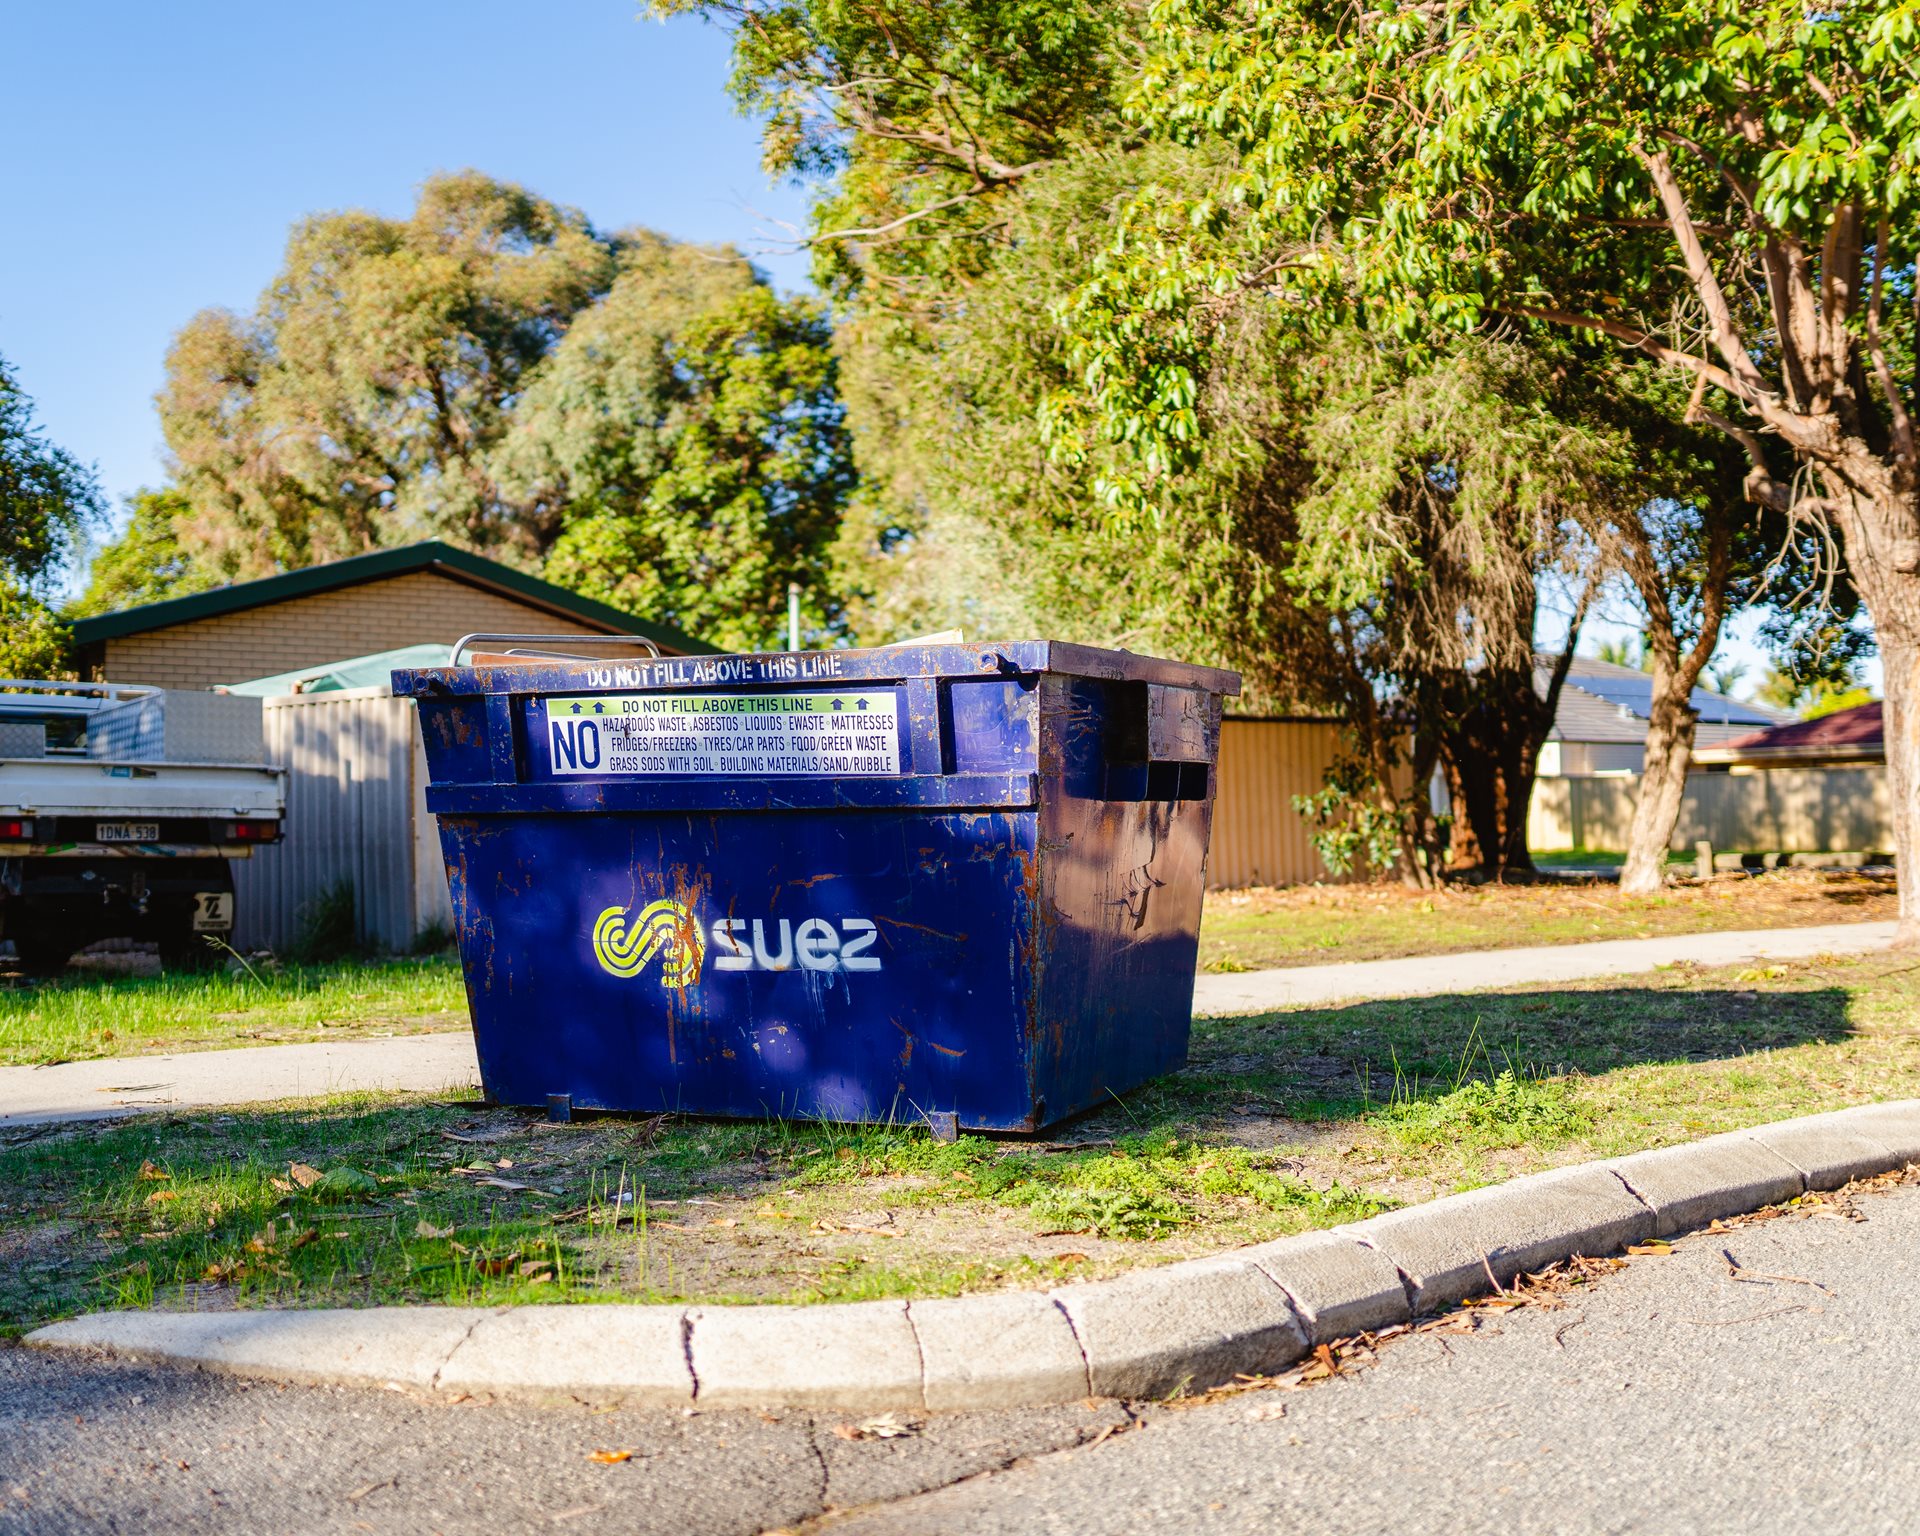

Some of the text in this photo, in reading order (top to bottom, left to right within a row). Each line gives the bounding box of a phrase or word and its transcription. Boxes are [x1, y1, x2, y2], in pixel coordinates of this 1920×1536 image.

[586, 654, 843, 687] DO NOT FILL ABOVE THIS LINE
[623, 698, 813, 713] DO NOT FILL ABOVE THIS LINE
[602, 715, 893, 732] HAZARDOUS WASTE ASBESTOS LIQUIDS EWASTE MATTRESSES
[552, 720, 600, 770] NO
[611, 737, 697, 752] FRIDGES/FREEZERS
[703, 736, 753, 751] TYRES/CAR
[757, 736, 785, 751] PARTS
[855, 735, 887, 751] WASTE
[610, 756, 892, 772] GRASS SODS WITH SOIL BUILDING MATERIALS/SAND/RUBBLE
